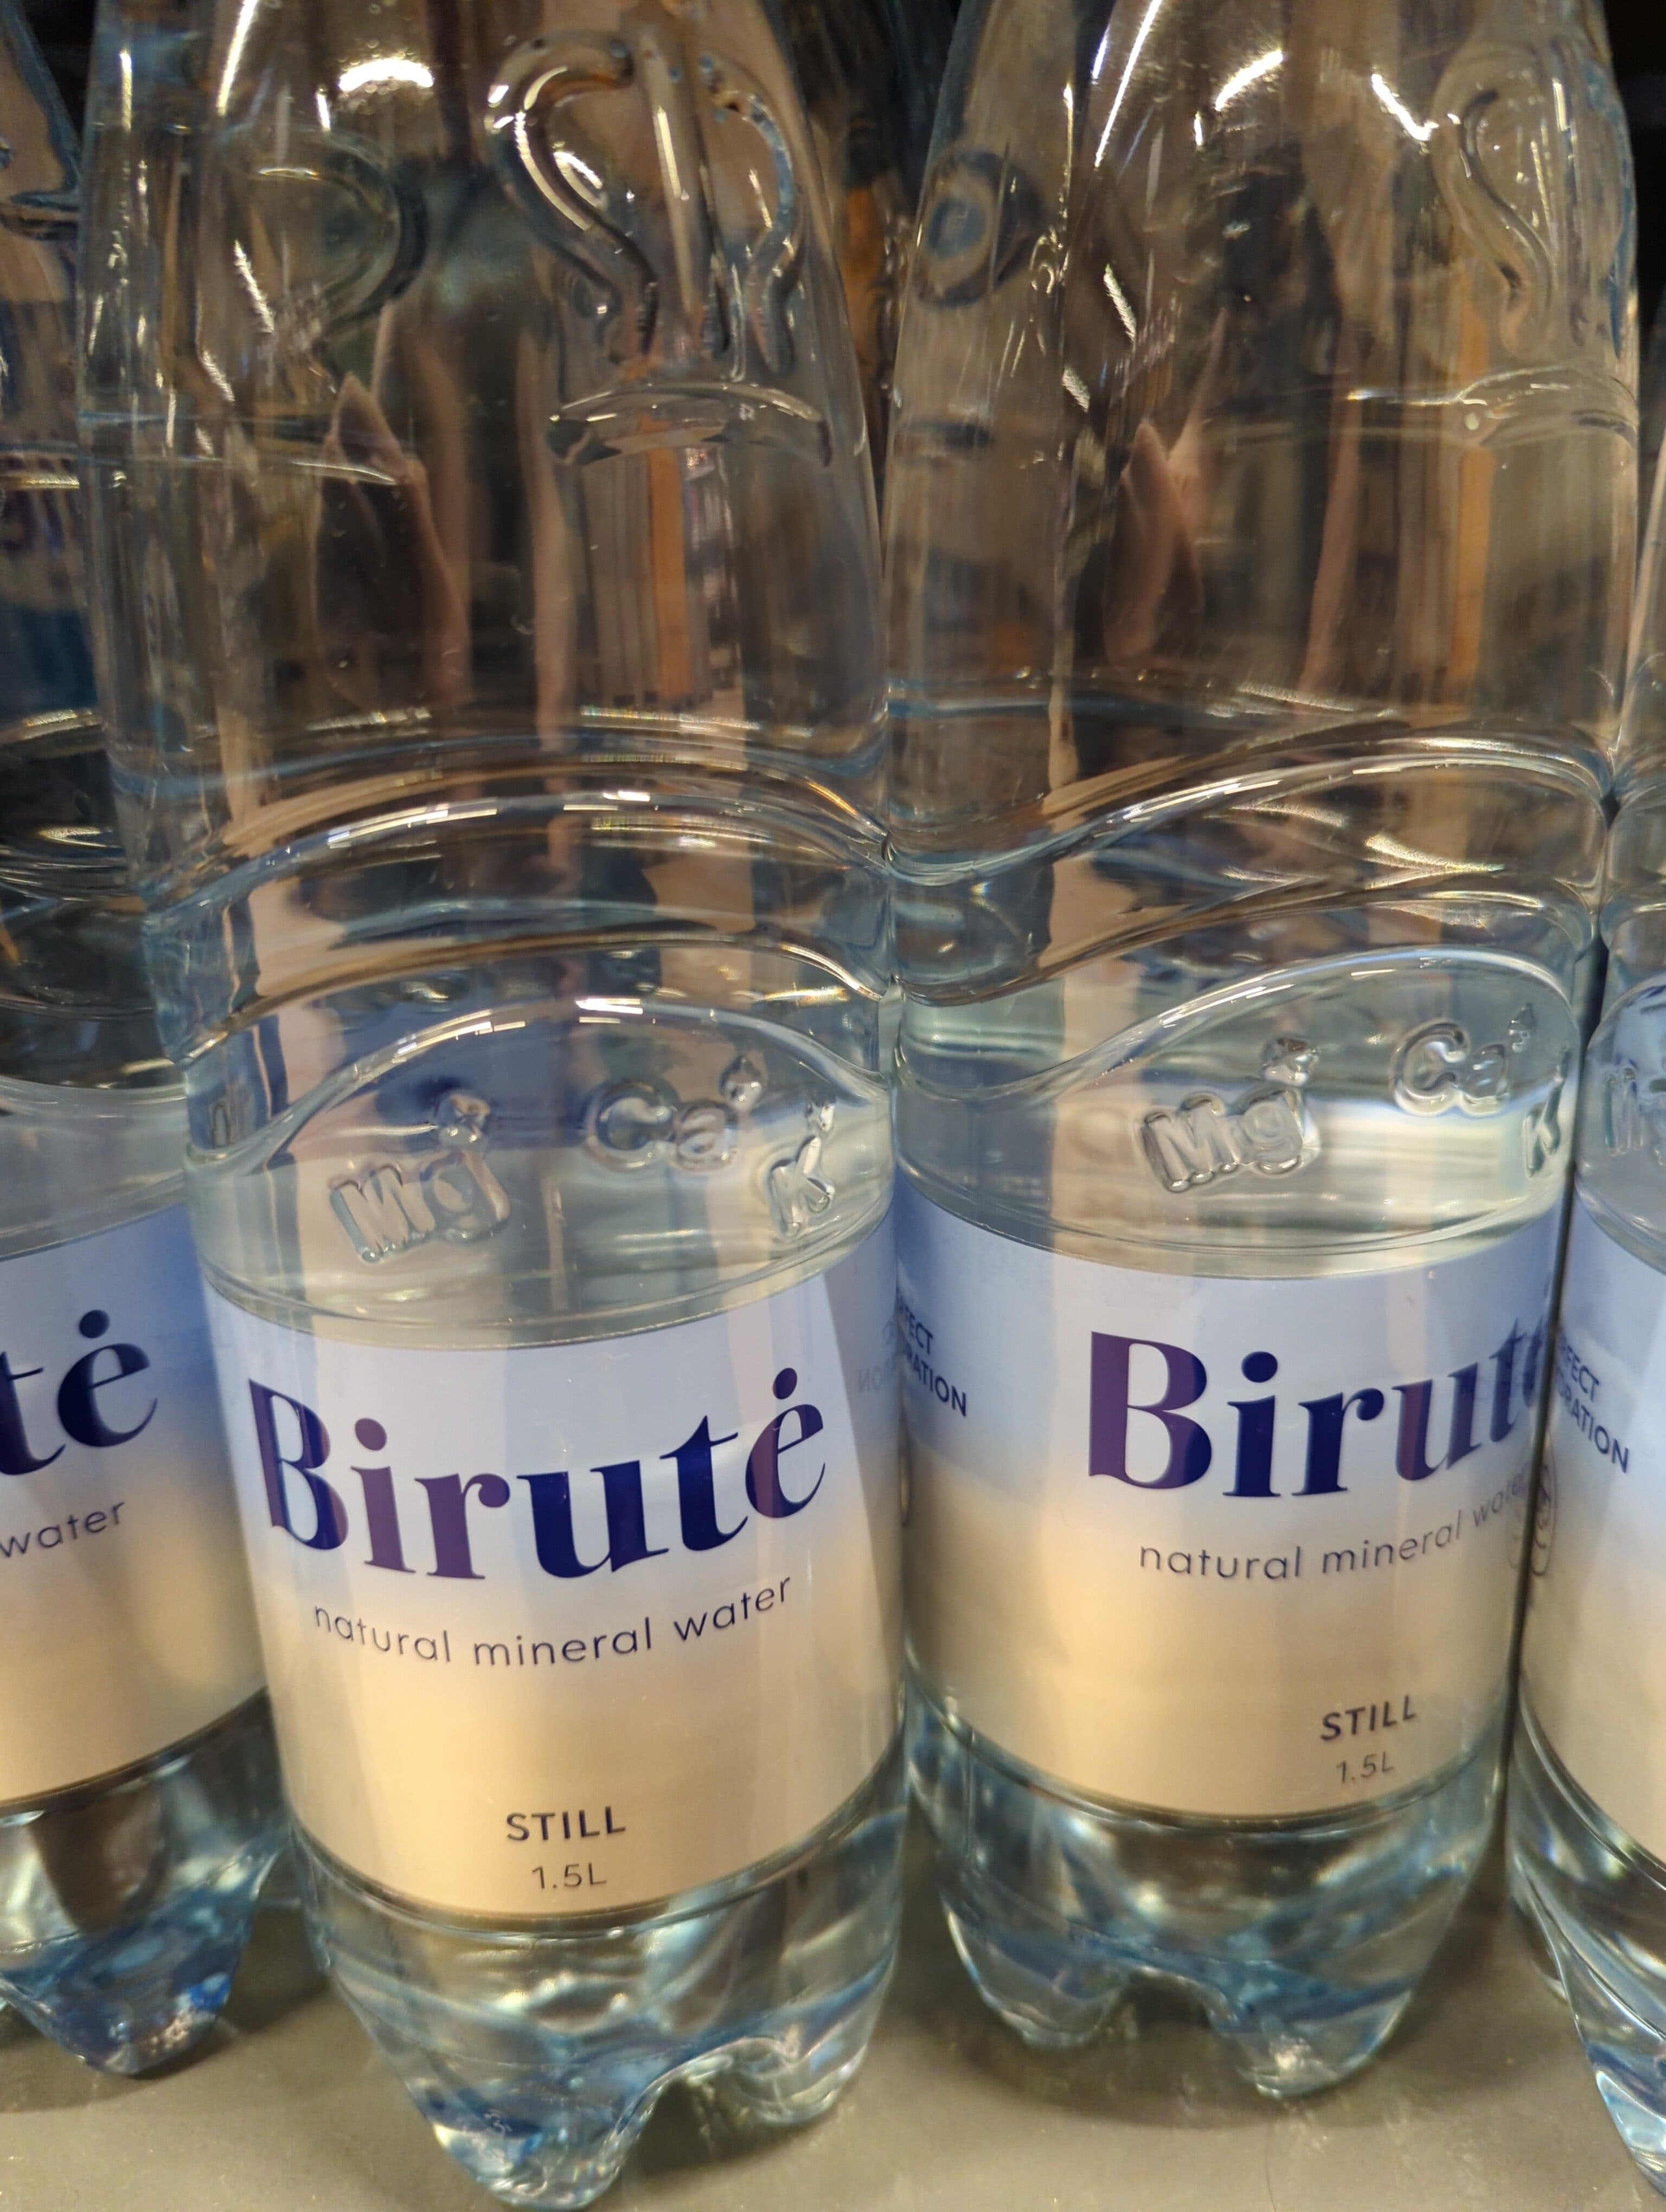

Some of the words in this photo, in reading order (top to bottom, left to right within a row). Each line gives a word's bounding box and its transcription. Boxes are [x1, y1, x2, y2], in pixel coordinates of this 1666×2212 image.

[249, 1367, 825, 1579] Birutė
[1139, 1546, 1302, 1580] natural
[1322, 1509, 1462, 1576] mineral
[315, 1605, 451, 1663] natural
[473, 1617, 652, 1667] mineral
[674, 1576, 791, 1642] water
[1319, 1693, 1417, 1741] STILL
[1336, 1750, 1394, 1784] 1.5L
[506, 1805, 626, 1841] STILL
[531, 1862, 607, 1889] 1.5L
